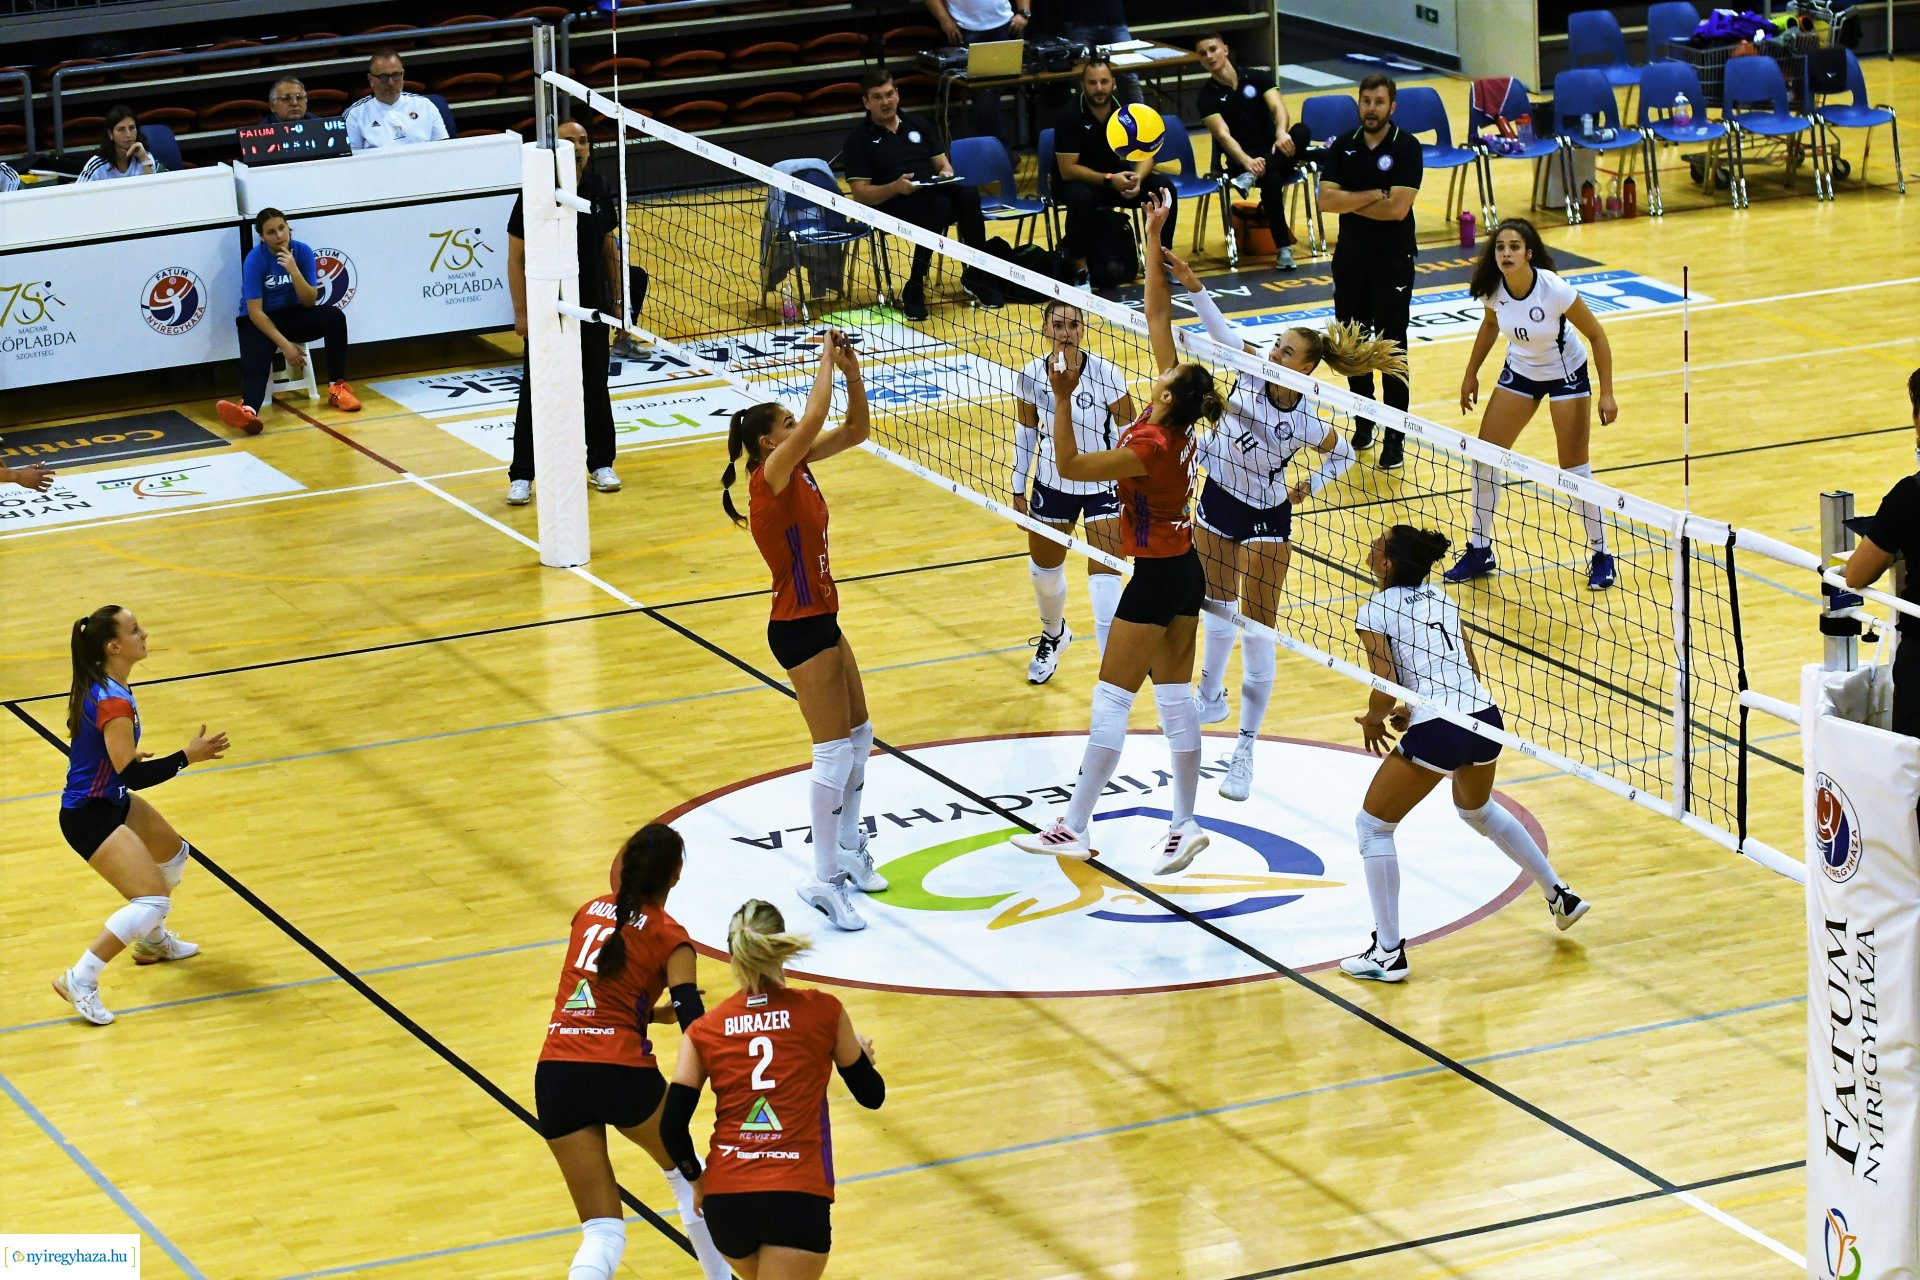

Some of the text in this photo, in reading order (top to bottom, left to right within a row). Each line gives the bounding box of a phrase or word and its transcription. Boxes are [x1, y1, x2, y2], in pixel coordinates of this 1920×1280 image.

[313, 250, 340, 258] ATUM
[155, 268, 190, 281] FATUM
[448, 271, 476, 280] MAGYAR
[422, 277, 504, 298] RÖPLABDA
[18, 325, 48, 334] MAGYAR
[0, 331, 77, 352] ÖPLABDA
[1427, 621, 1454, 651] 7
[559, 1027, 615, 1035] BESTRONG
[724, 1010, 791, 1036] BURAZER
[1822, 913, 1861, 1176] FATUM
[748, 1036, 776, 1091] 2
[1854, 927, 1885, 1186] NYÍREGYHÁZA
[736, 1151, 800, 1159] BESTRONG
